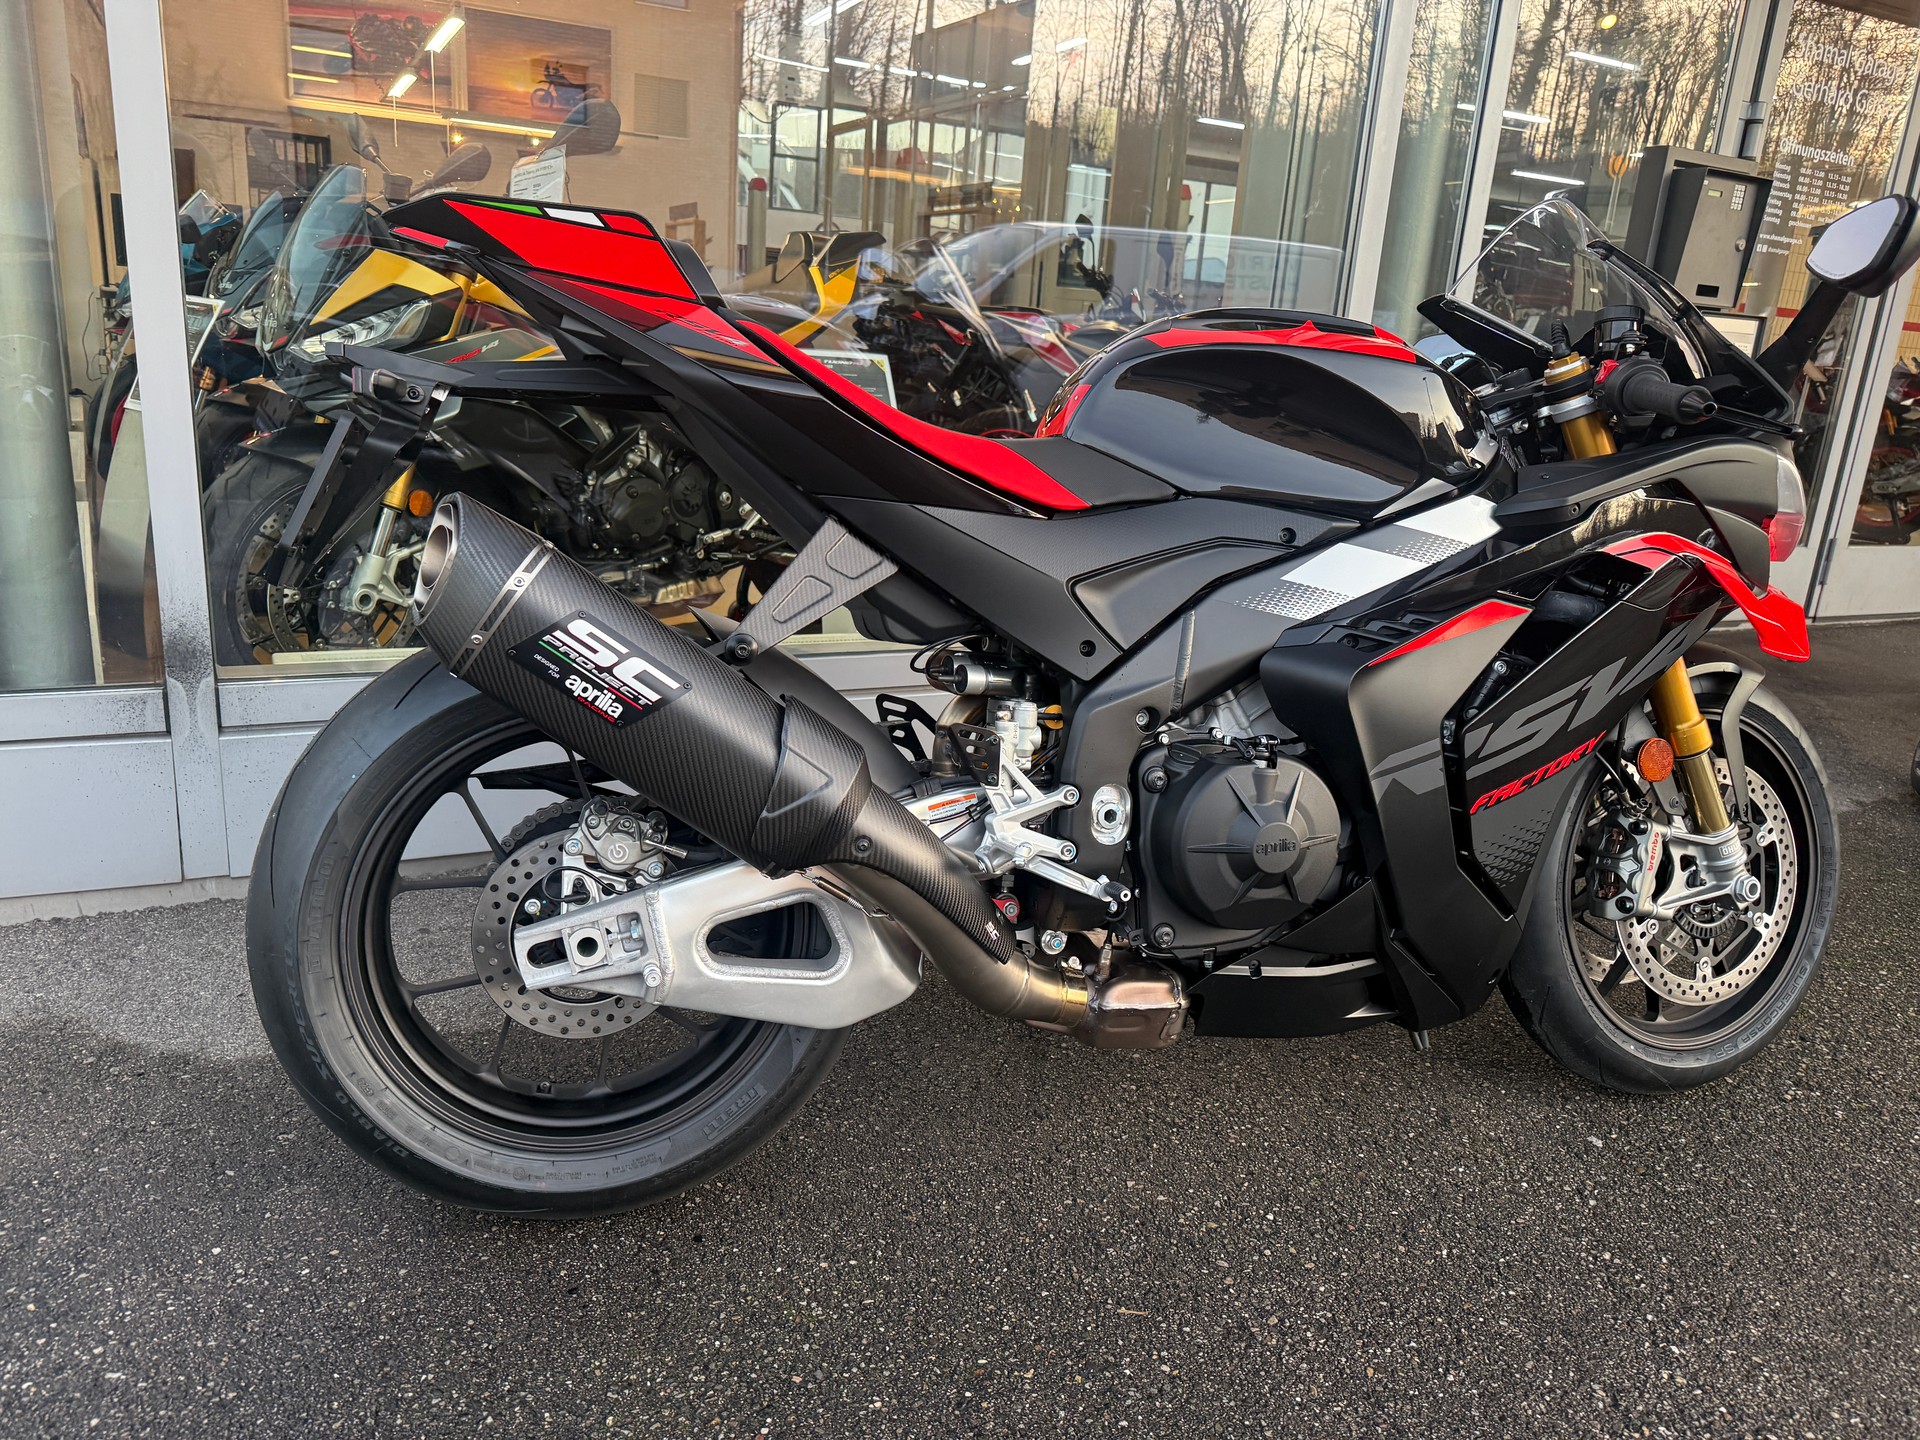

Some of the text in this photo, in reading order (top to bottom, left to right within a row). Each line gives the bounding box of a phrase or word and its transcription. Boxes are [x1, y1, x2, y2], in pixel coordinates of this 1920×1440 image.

[1799, 32, 1853, 68] Shamal
[1793, 79, 1854, 111] Gerhard
[1780, 138, 1855, 167] Öffnungszeiten
[533, 653, 560, 672] DESIGNED
[542, 635, 653, 706] PROJECT
[547, 669, 561, 679] FOR
[551, 619, 682, 703] SC
[564, 674, 624, 719] aprilia
[577, 696, 616, 723] RACING
[1470, 729, 1607, 815] FACTORY
[1255, 838, 1297, 856] aprilia
[1647, 832, 1660, 872] brembo
[1741, 965, 1808, 1044] SUPERCORSA
[335, 1090, 410, 1158] DIABLO
[702, 1083, 768, 1140] PIRELLI
